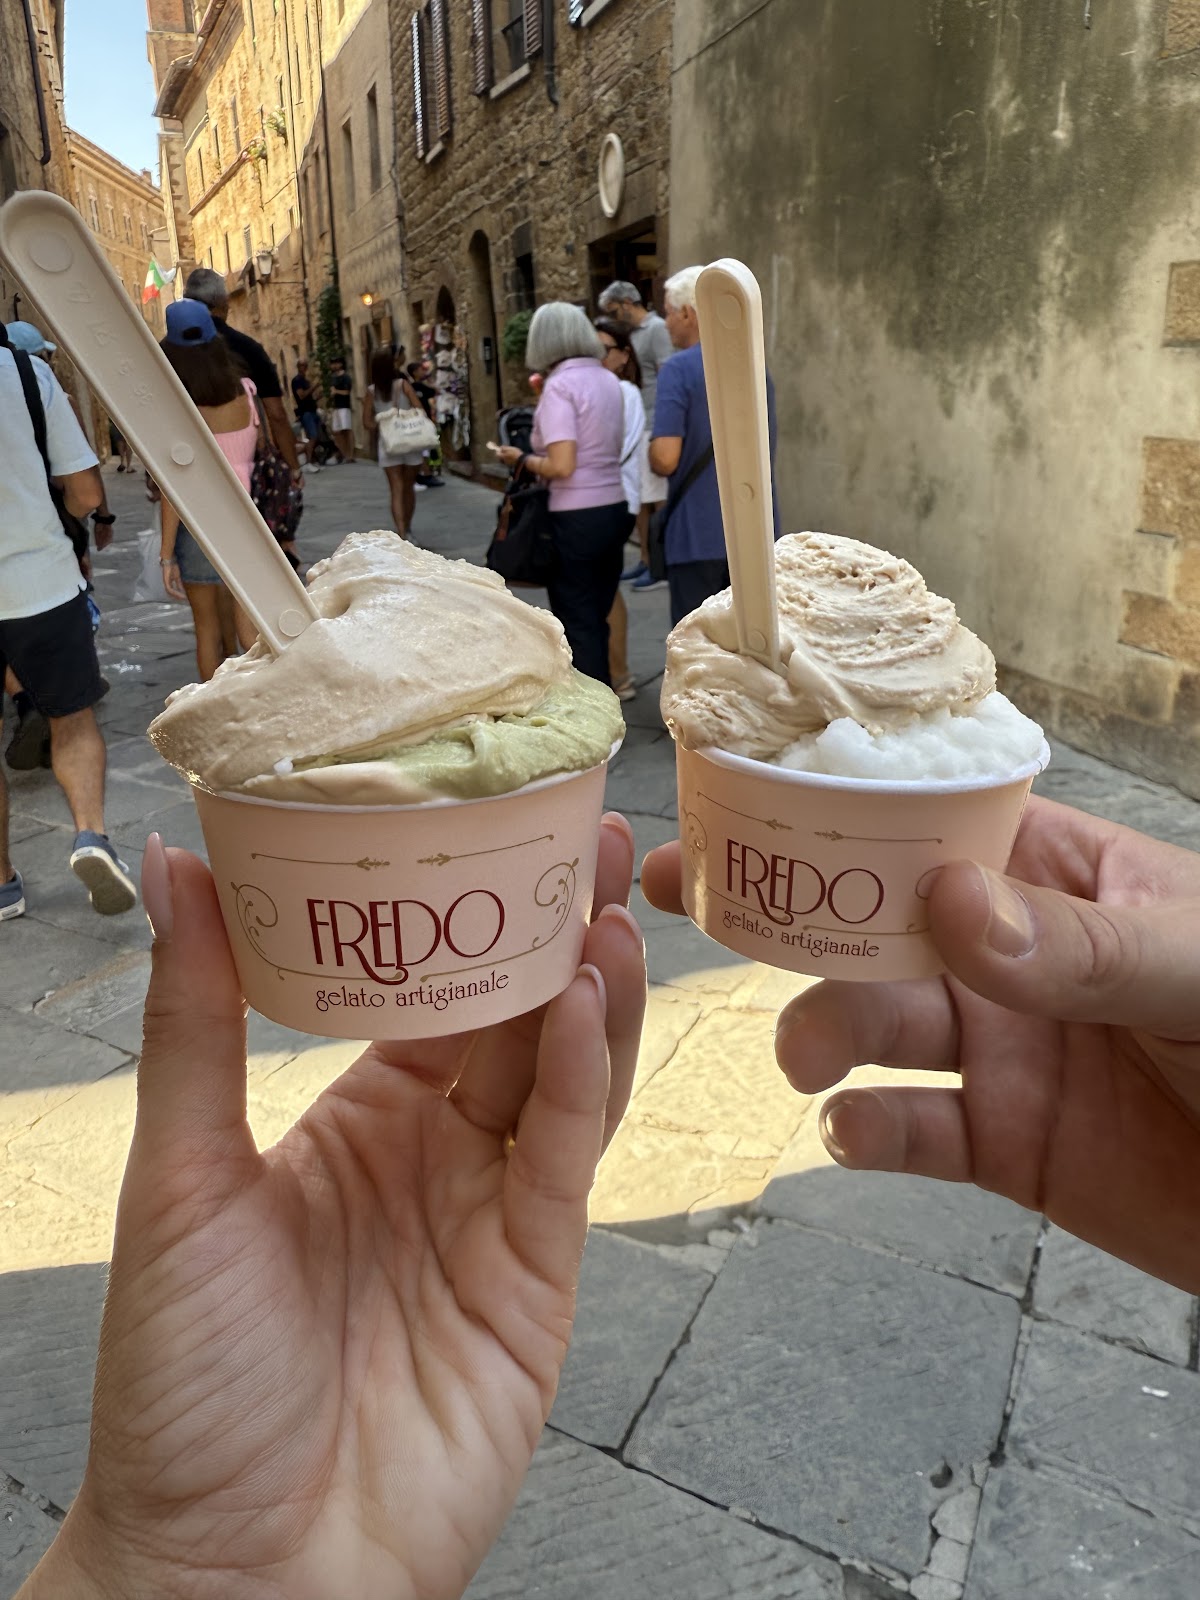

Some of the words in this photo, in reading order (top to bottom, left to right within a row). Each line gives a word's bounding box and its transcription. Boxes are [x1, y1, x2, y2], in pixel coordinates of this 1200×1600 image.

[726, 838, 885, 926] FREDO
[306, 889, 506, 986] FREDO
[723, 910, 773, 939] gelato
[780, 931, 880, 958] artigianale
[315, 985, 385, 1012] gelato
[395, 970, 510, 1011] artigianale
